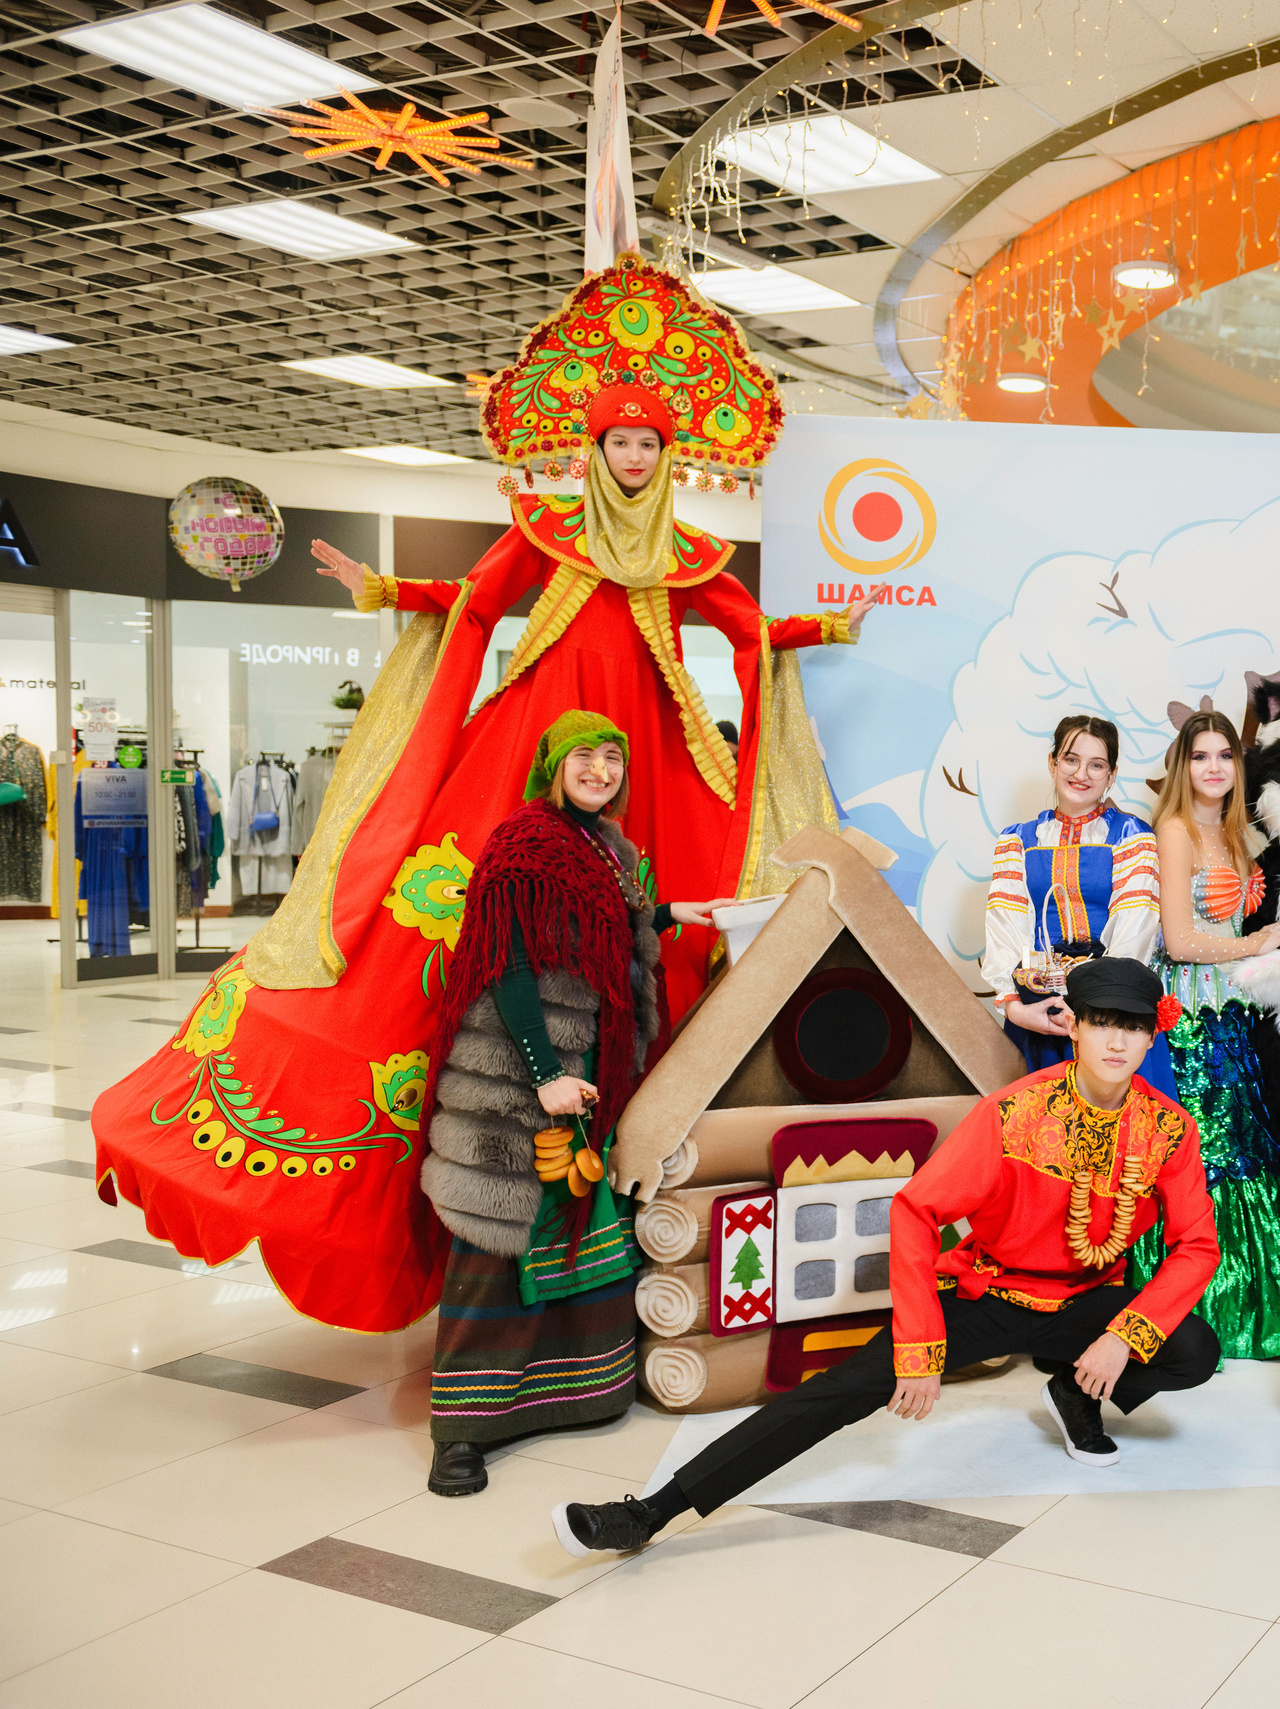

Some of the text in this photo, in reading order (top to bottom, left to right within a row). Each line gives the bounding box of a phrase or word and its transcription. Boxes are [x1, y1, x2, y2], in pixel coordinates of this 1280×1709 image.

[191, 517, 266, 533] НОВЫМ
[200, 535, 274, 557] ГОДОМ
[817, 583, 937, 606] ШАМСА
[88, 721, 115, 733] 50%
